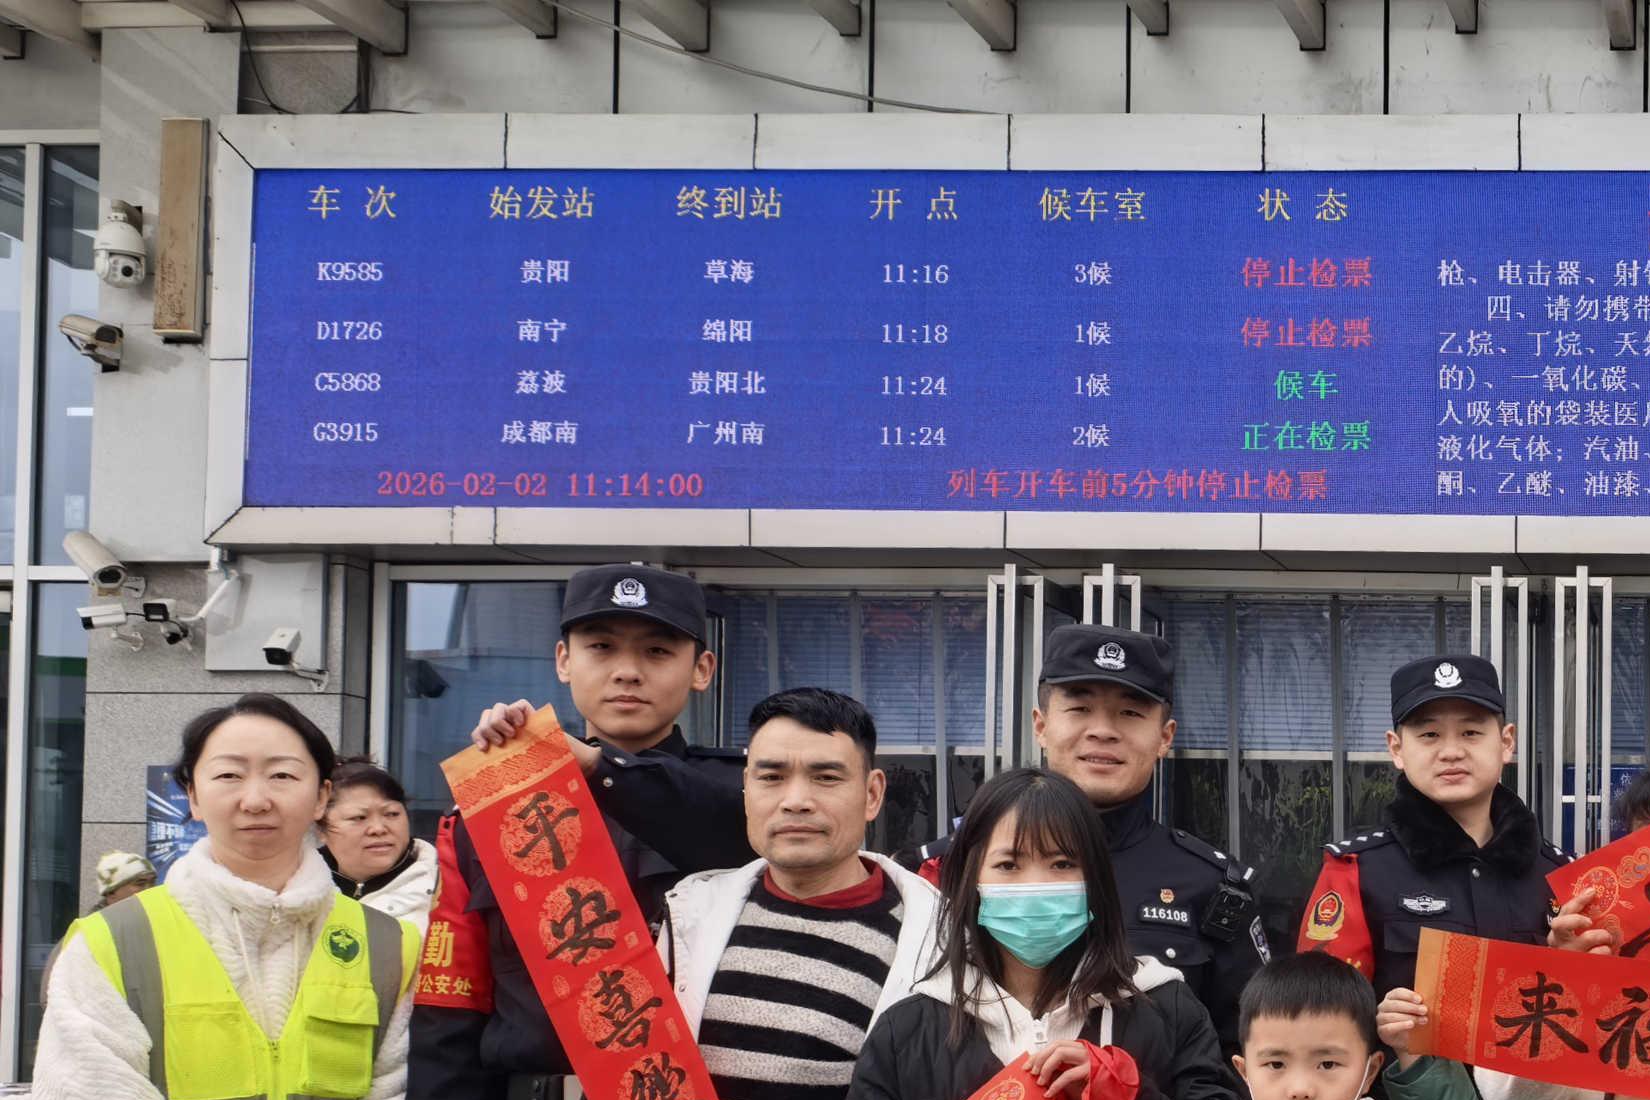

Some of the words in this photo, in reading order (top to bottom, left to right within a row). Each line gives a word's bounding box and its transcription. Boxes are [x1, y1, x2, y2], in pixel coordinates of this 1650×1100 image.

[307, 184, 397, 220] 车次
[489, 185, 595, 220] 始发站
[676, 185, 783, 220] 终到站
[869, 186, 958, 221] 开点
[1039, 186, 1146, 222] 候车室
[1256, 187, 1348, 222] 状态
[317, 262, 383, 282] K9585
[519, 259, 569, 283] 贵阳
[703, 259, 754, 284] 草海
[883, 263, 949, 284] 11:16
[1074, 261, 1113, 286] 3候
[1242, 256, 1373, 288] 停止检票
[317, 321, 383, 341] D1726
[516, 318, 567, 343] 南宁
[703, 319, 752, 343] 绵阳
[882, 323, 948, 344] 11:18
[1075, 320, 1112, 346] 1候
[1241, 317, 1373, 348] 停止检票
[314, 372, 381, 392] C5868
[516, 370, 566, 394] 荔波
[688, 370, 766, 395] 贵阳北
[881, 375, 947, 396] 11:24
[1075, 373, 1111, 398] 1候
[1273, 369, 1339, 401] 候车
[313, 422, 378, 442] G3915
[501, 420, 578, 444] 成都南
[687, 420, 765, 446] 广州南
[880, 426, 946, 446] 11:24
[1072, 423, 1110, 448] 2候
[1241, 420, 1372, 451] 正在检票
[378, 471, 547, 497] 2026-02-02
[569, 472, 704, 497] 11:14:00
[949, 468, 1328, 501] 列车开车前5分钟停止检票
[1142, 905, 1189, 924] 116108
